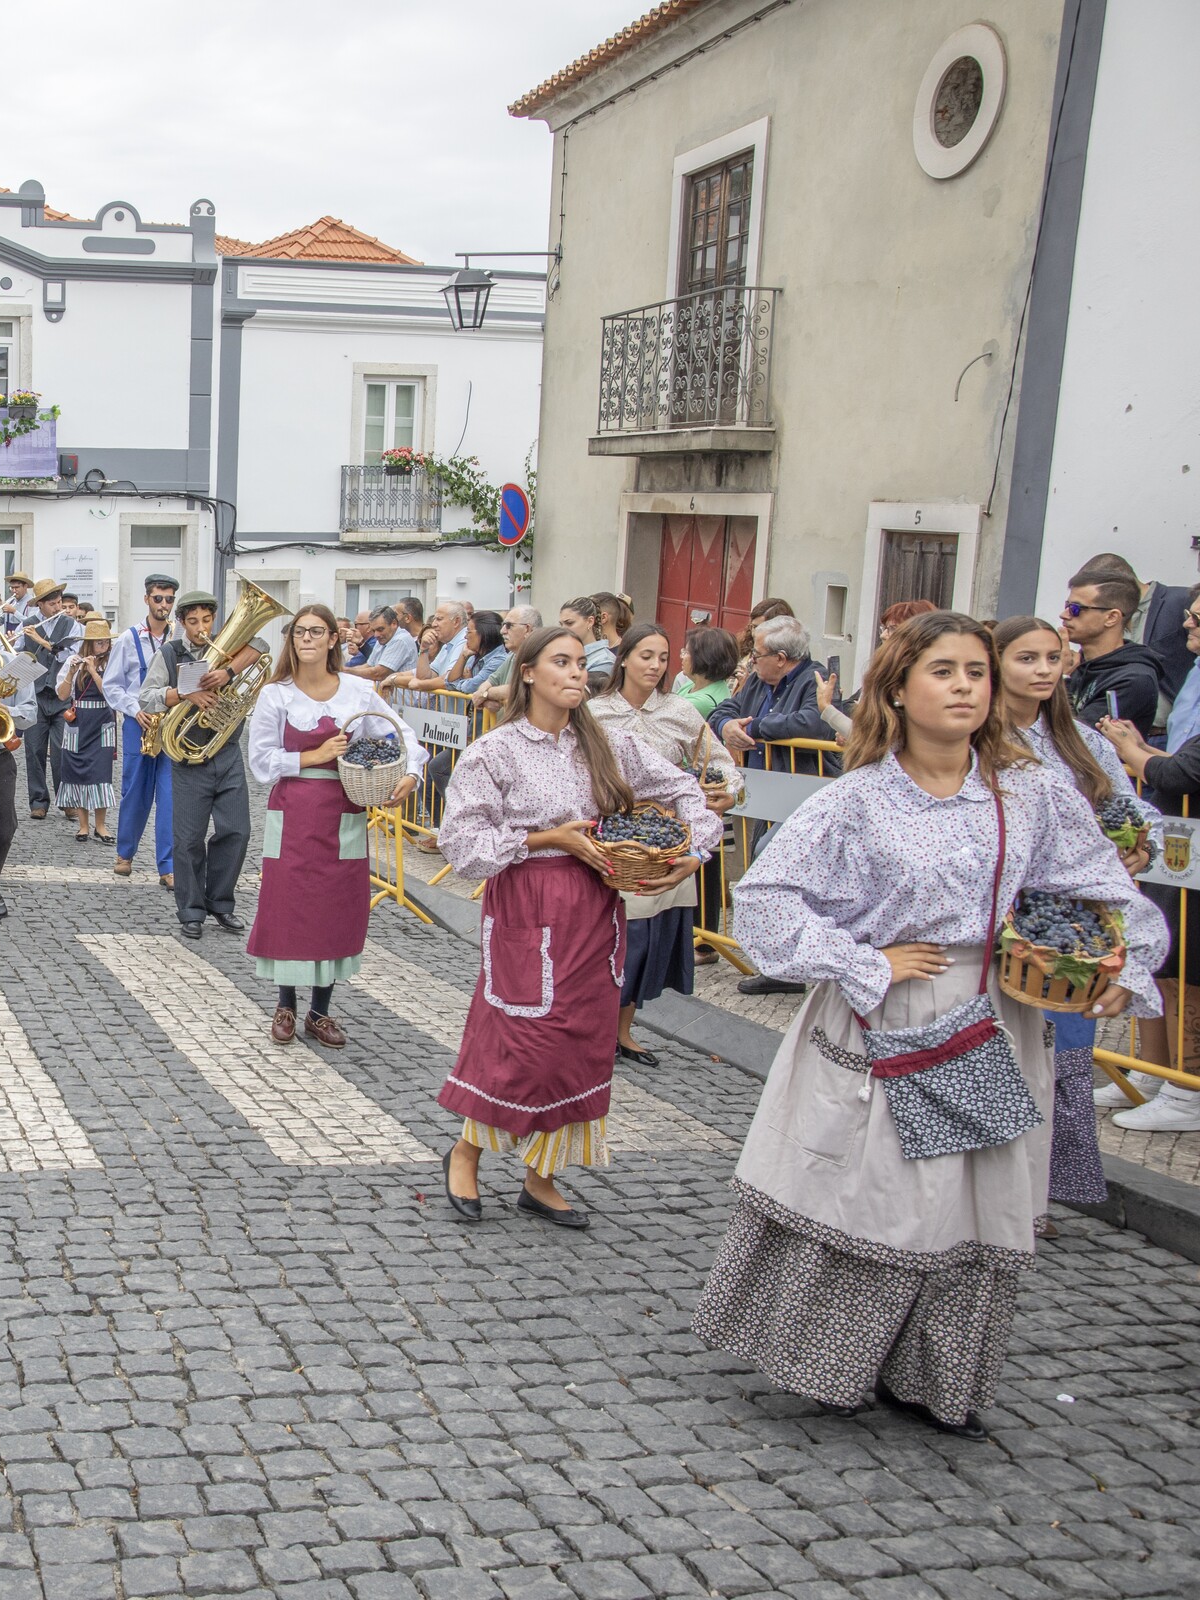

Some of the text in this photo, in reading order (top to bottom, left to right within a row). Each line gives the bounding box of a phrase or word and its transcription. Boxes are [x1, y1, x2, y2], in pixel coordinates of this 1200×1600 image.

[689, 496, 695, 511] 6
[914, 510, 921, 525] 5
[422, 722, 459, 744] Palmela
